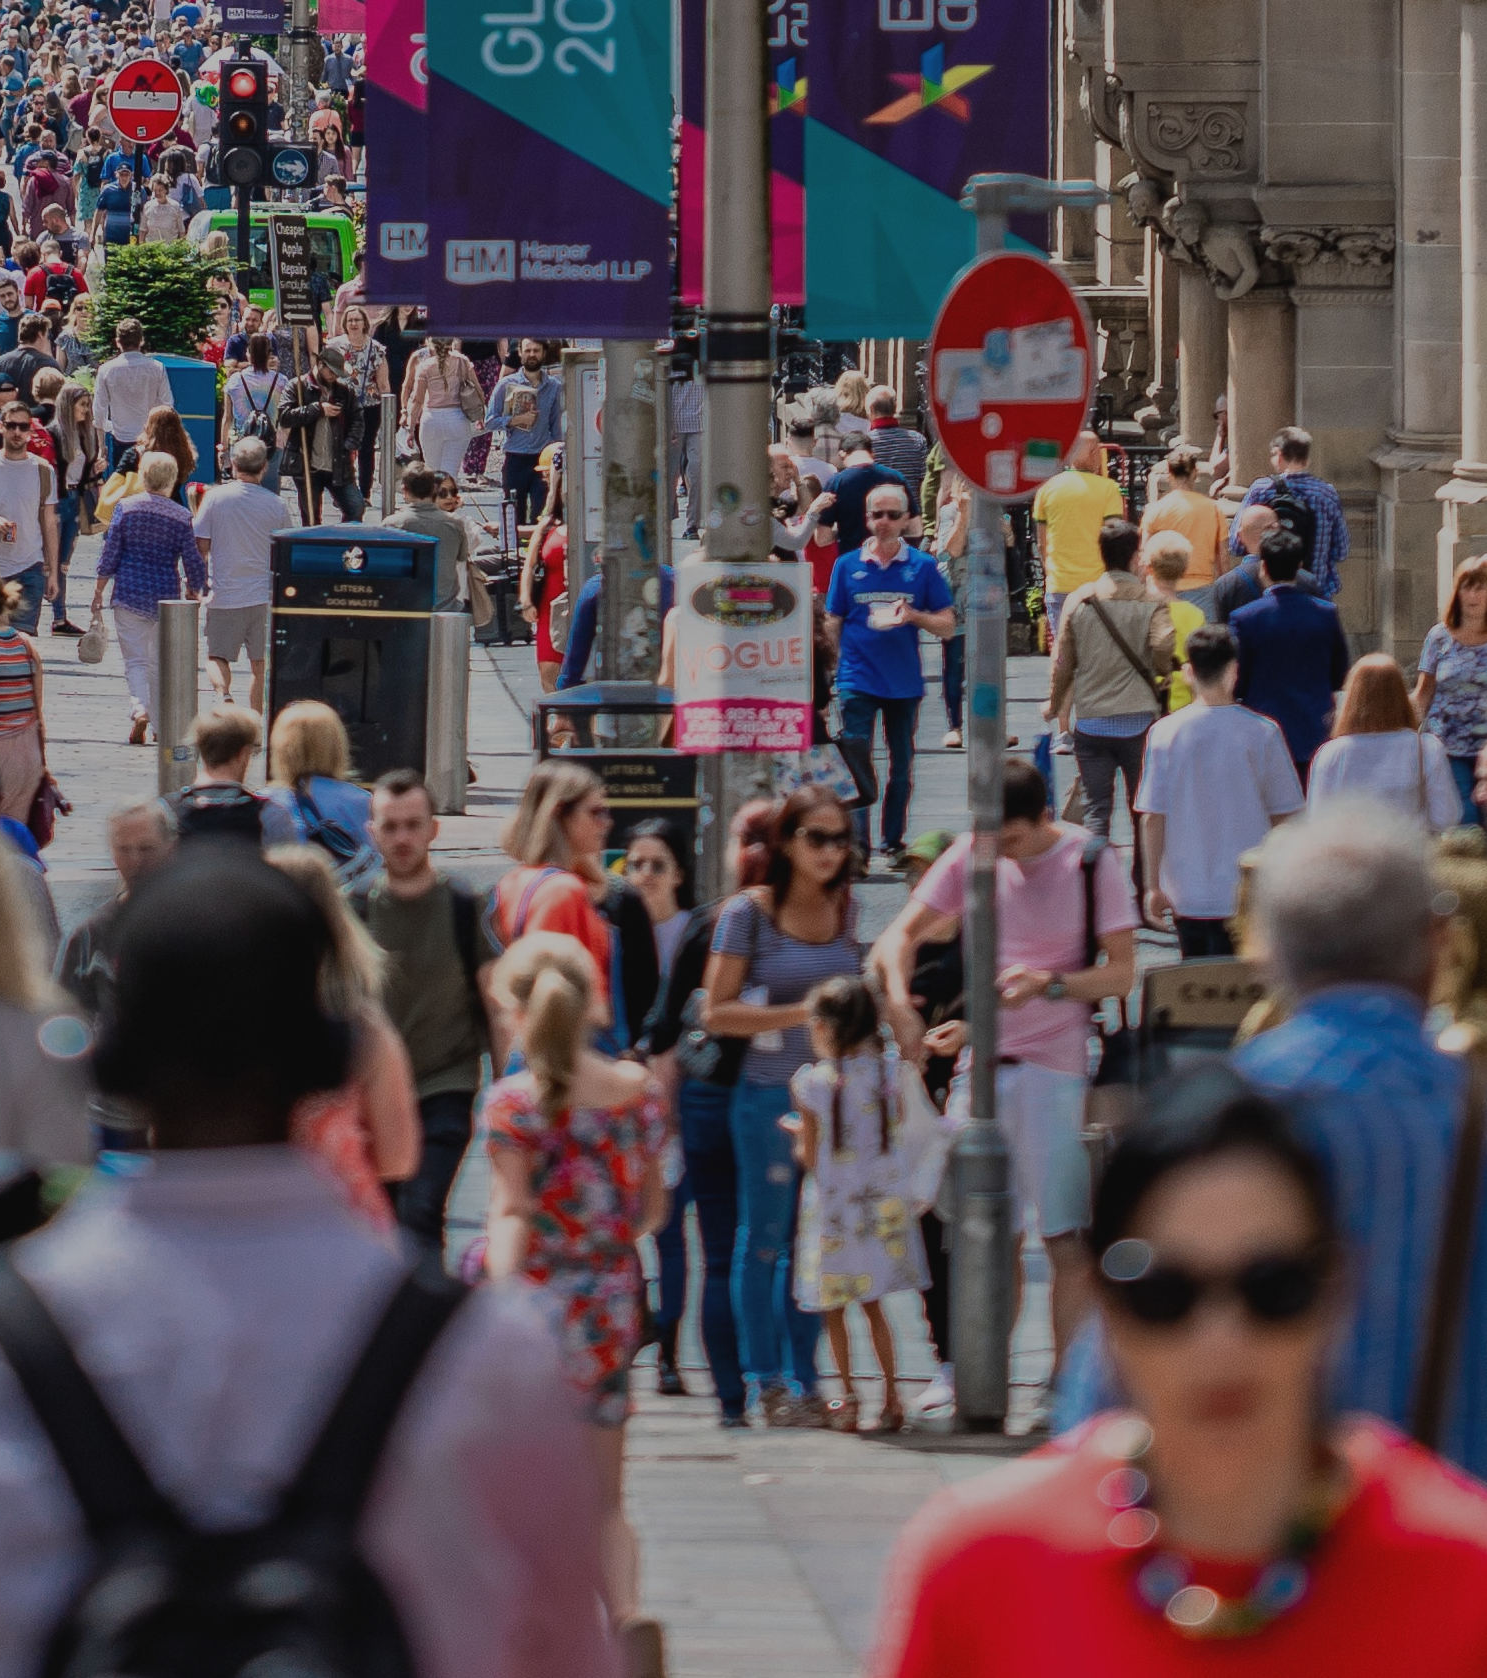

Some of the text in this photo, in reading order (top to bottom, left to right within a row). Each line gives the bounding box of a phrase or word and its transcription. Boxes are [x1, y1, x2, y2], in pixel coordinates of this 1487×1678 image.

[276, 222, 305, 239] Cheaper
[281, 242, 304, 258] Apple
[520, 240, 591, 261] Harper
[454, 245, 510, 275] HM
[280, 262, 308, 277] Repairs
[520, 260, 652, 281] Macleod LLP
[333, 584, 365, 594] LITTER
[326, 597, 380, 608] DOG WASTE
[680, 636, 805, 688] VOGUE
